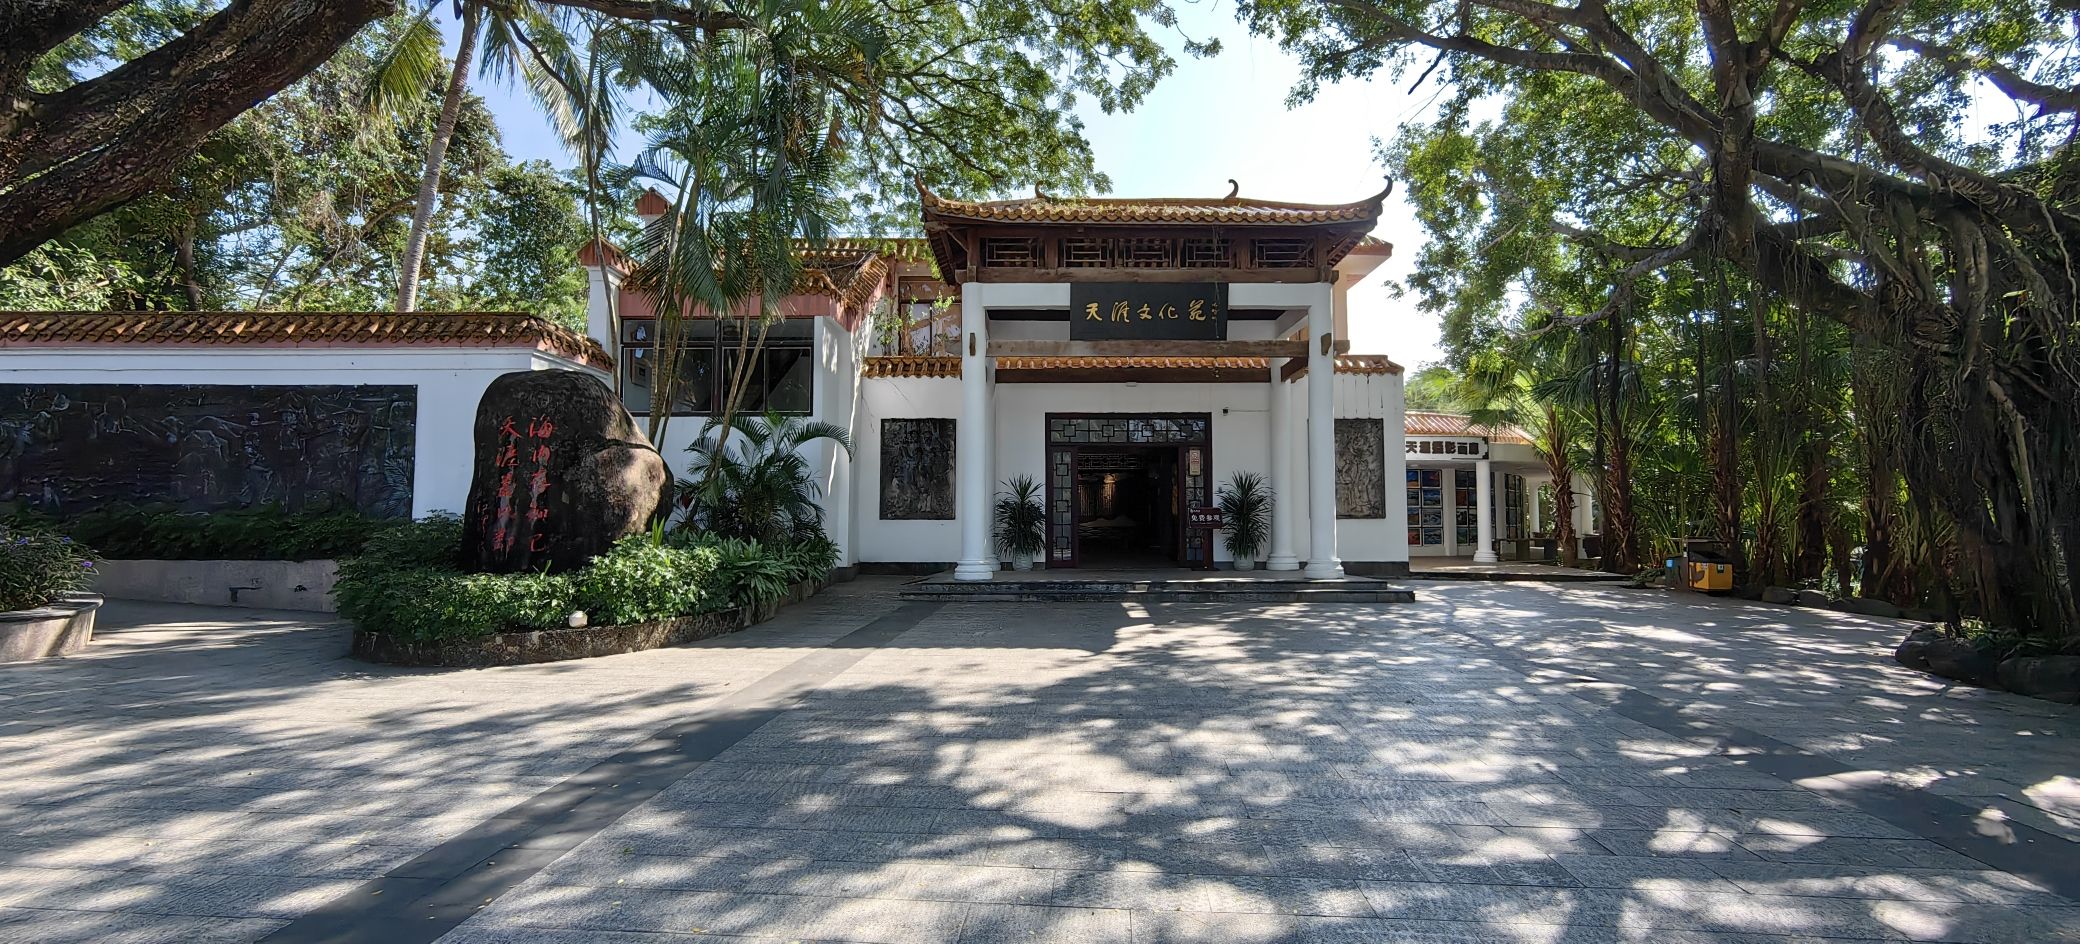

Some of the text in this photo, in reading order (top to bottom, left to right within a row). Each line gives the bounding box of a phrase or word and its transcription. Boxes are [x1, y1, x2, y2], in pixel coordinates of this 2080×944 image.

[1085, 299, 1206, 322] 天涯文化苑
[1191, 514, 1221, 522] 免费参观
